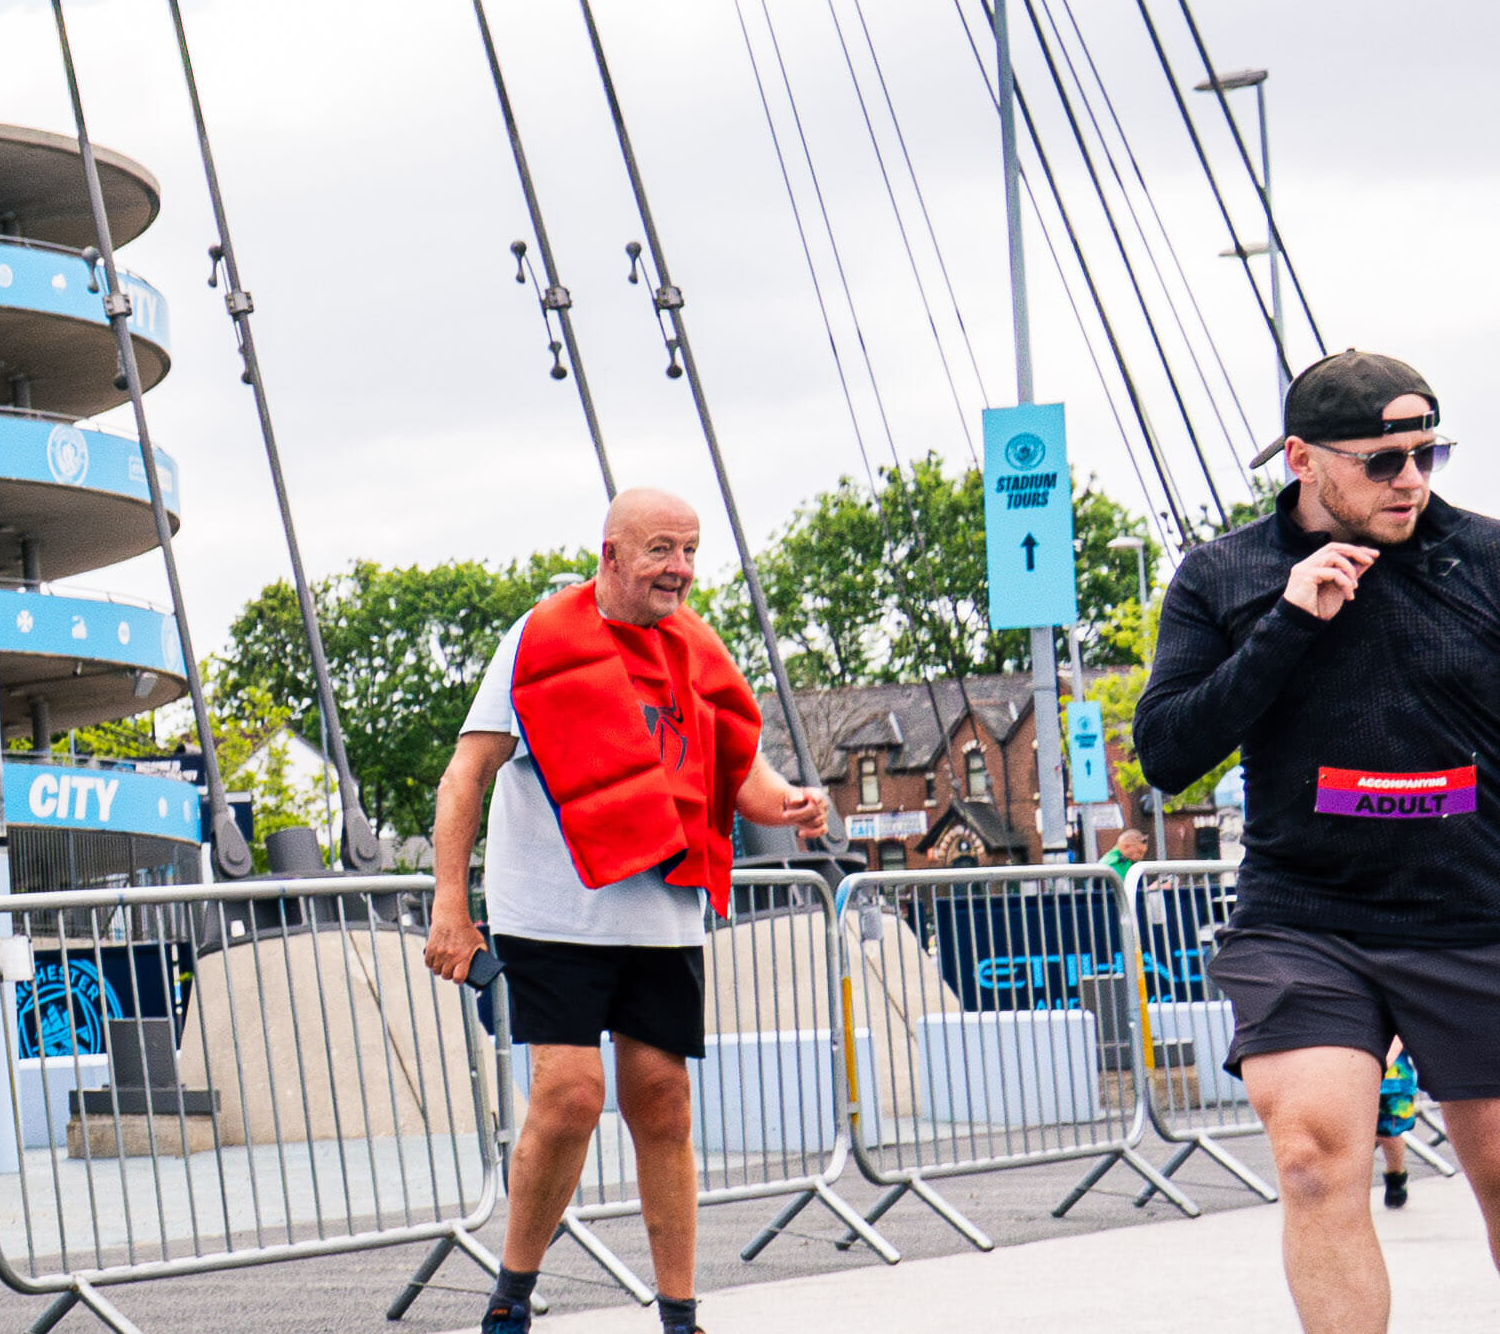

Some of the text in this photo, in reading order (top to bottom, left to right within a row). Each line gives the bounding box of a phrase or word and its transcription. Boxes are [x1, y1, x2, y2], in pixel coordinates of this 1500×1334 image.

[995, 472, 1058, 494] STADIUM
[1006, 491, 1050, 511] TOURS
[1357, 776, 1448, 789] ACCOMPANYING
[29, 774, 121, 823] CITY
[1354, 793, 1448, 814] ADULT
